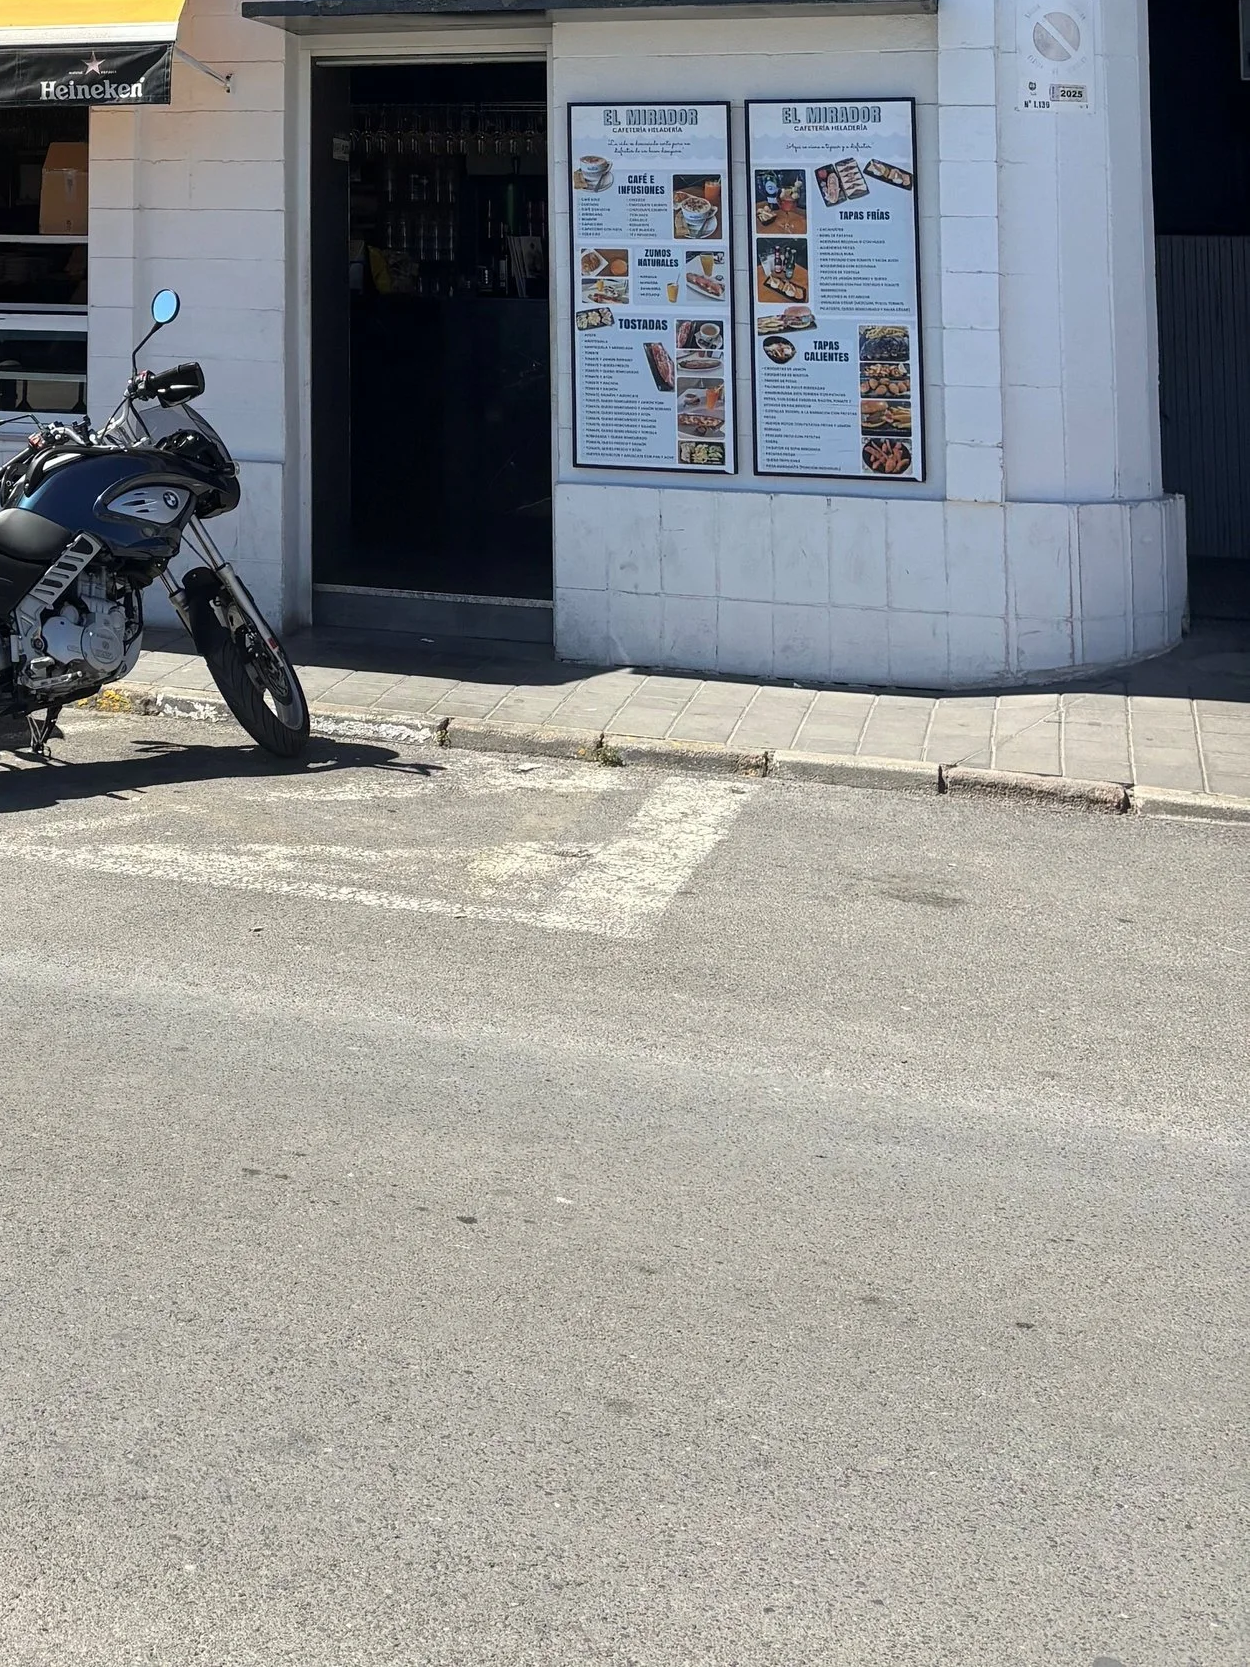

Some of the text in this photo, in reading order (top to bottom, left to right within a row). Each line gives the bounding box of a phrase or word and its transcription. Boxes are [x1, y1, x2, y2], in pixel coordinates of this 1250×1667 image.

[39, 79, 144, 101] Heineken
[1060, 89, 1083, 99] 2025
[603, 108, 699, 126] EL MIRADOR
[782, 105, 882, 124] EL MIRADOR
[627, 173, 655, 184] CAFÉ E
[618, 185, 665, 195] INFUSIONES
[839, 208, 890, 221] TAPAS FRÍAS
[644, 248, 672, 258] ZUMOS
[637, 258, 679, 268] NATURALES
[618, 318, 668, 331] TOSTADAS
[813, 340, 840, 351] TAPAS
[804, 351, 850, 362] CALIENTES
